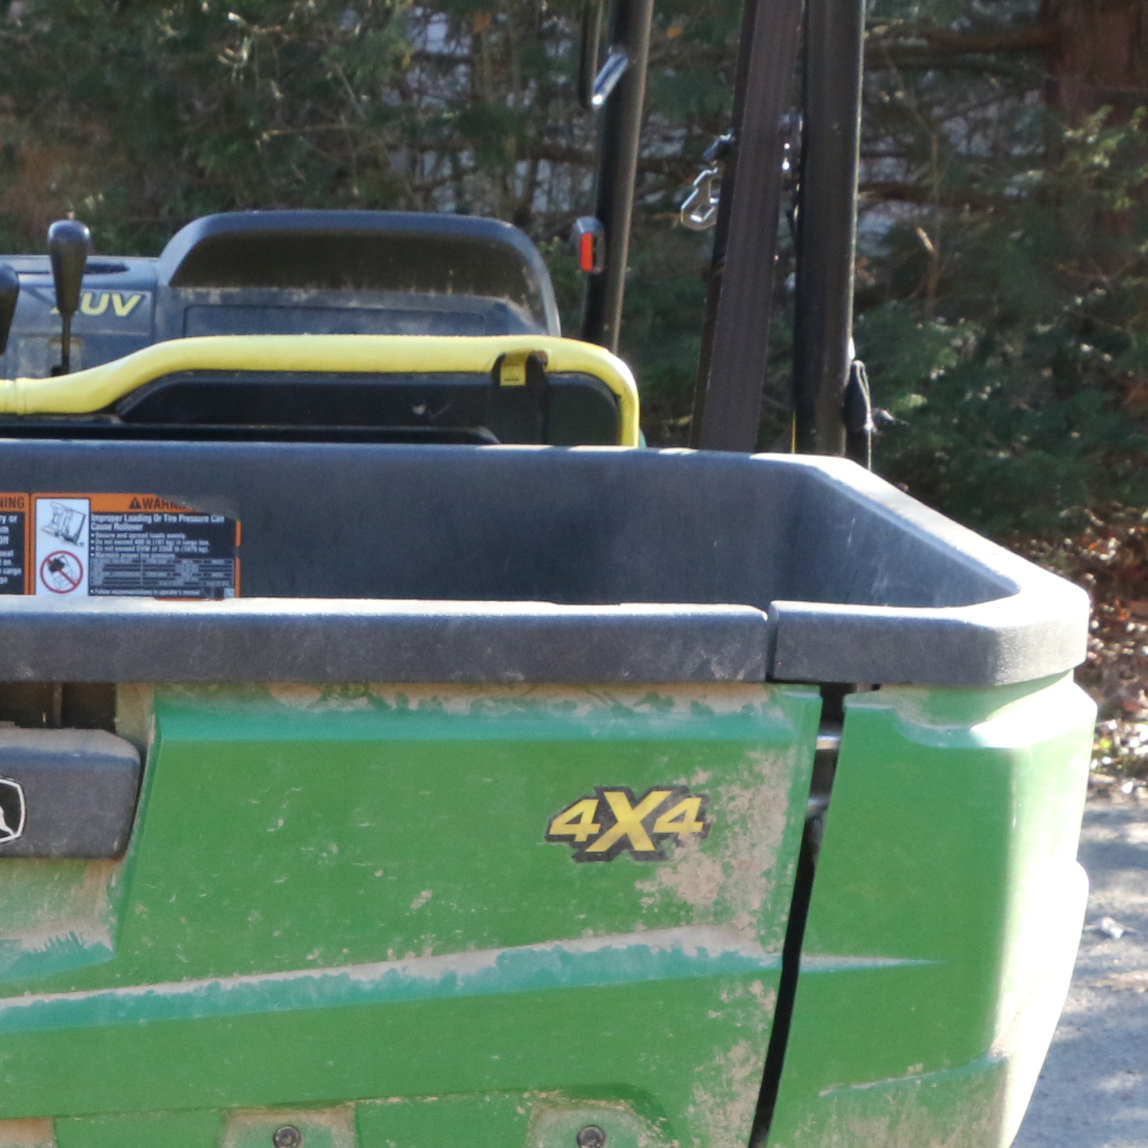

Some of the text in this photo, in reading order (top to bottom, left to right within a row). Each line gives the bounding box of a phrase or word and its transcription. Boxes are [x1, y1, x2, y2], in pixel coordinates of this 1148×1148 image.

[51, 293, 141, 317] UV
[8, 515, 17, 523] or
[91, 514, 225, 524] Improper Loading Or Tire Pressure Can
[91, 522, 144, 531] Cause Rollover
[0, 549, 14, 557] seat
[547, 788, 707, 856] 4X4
